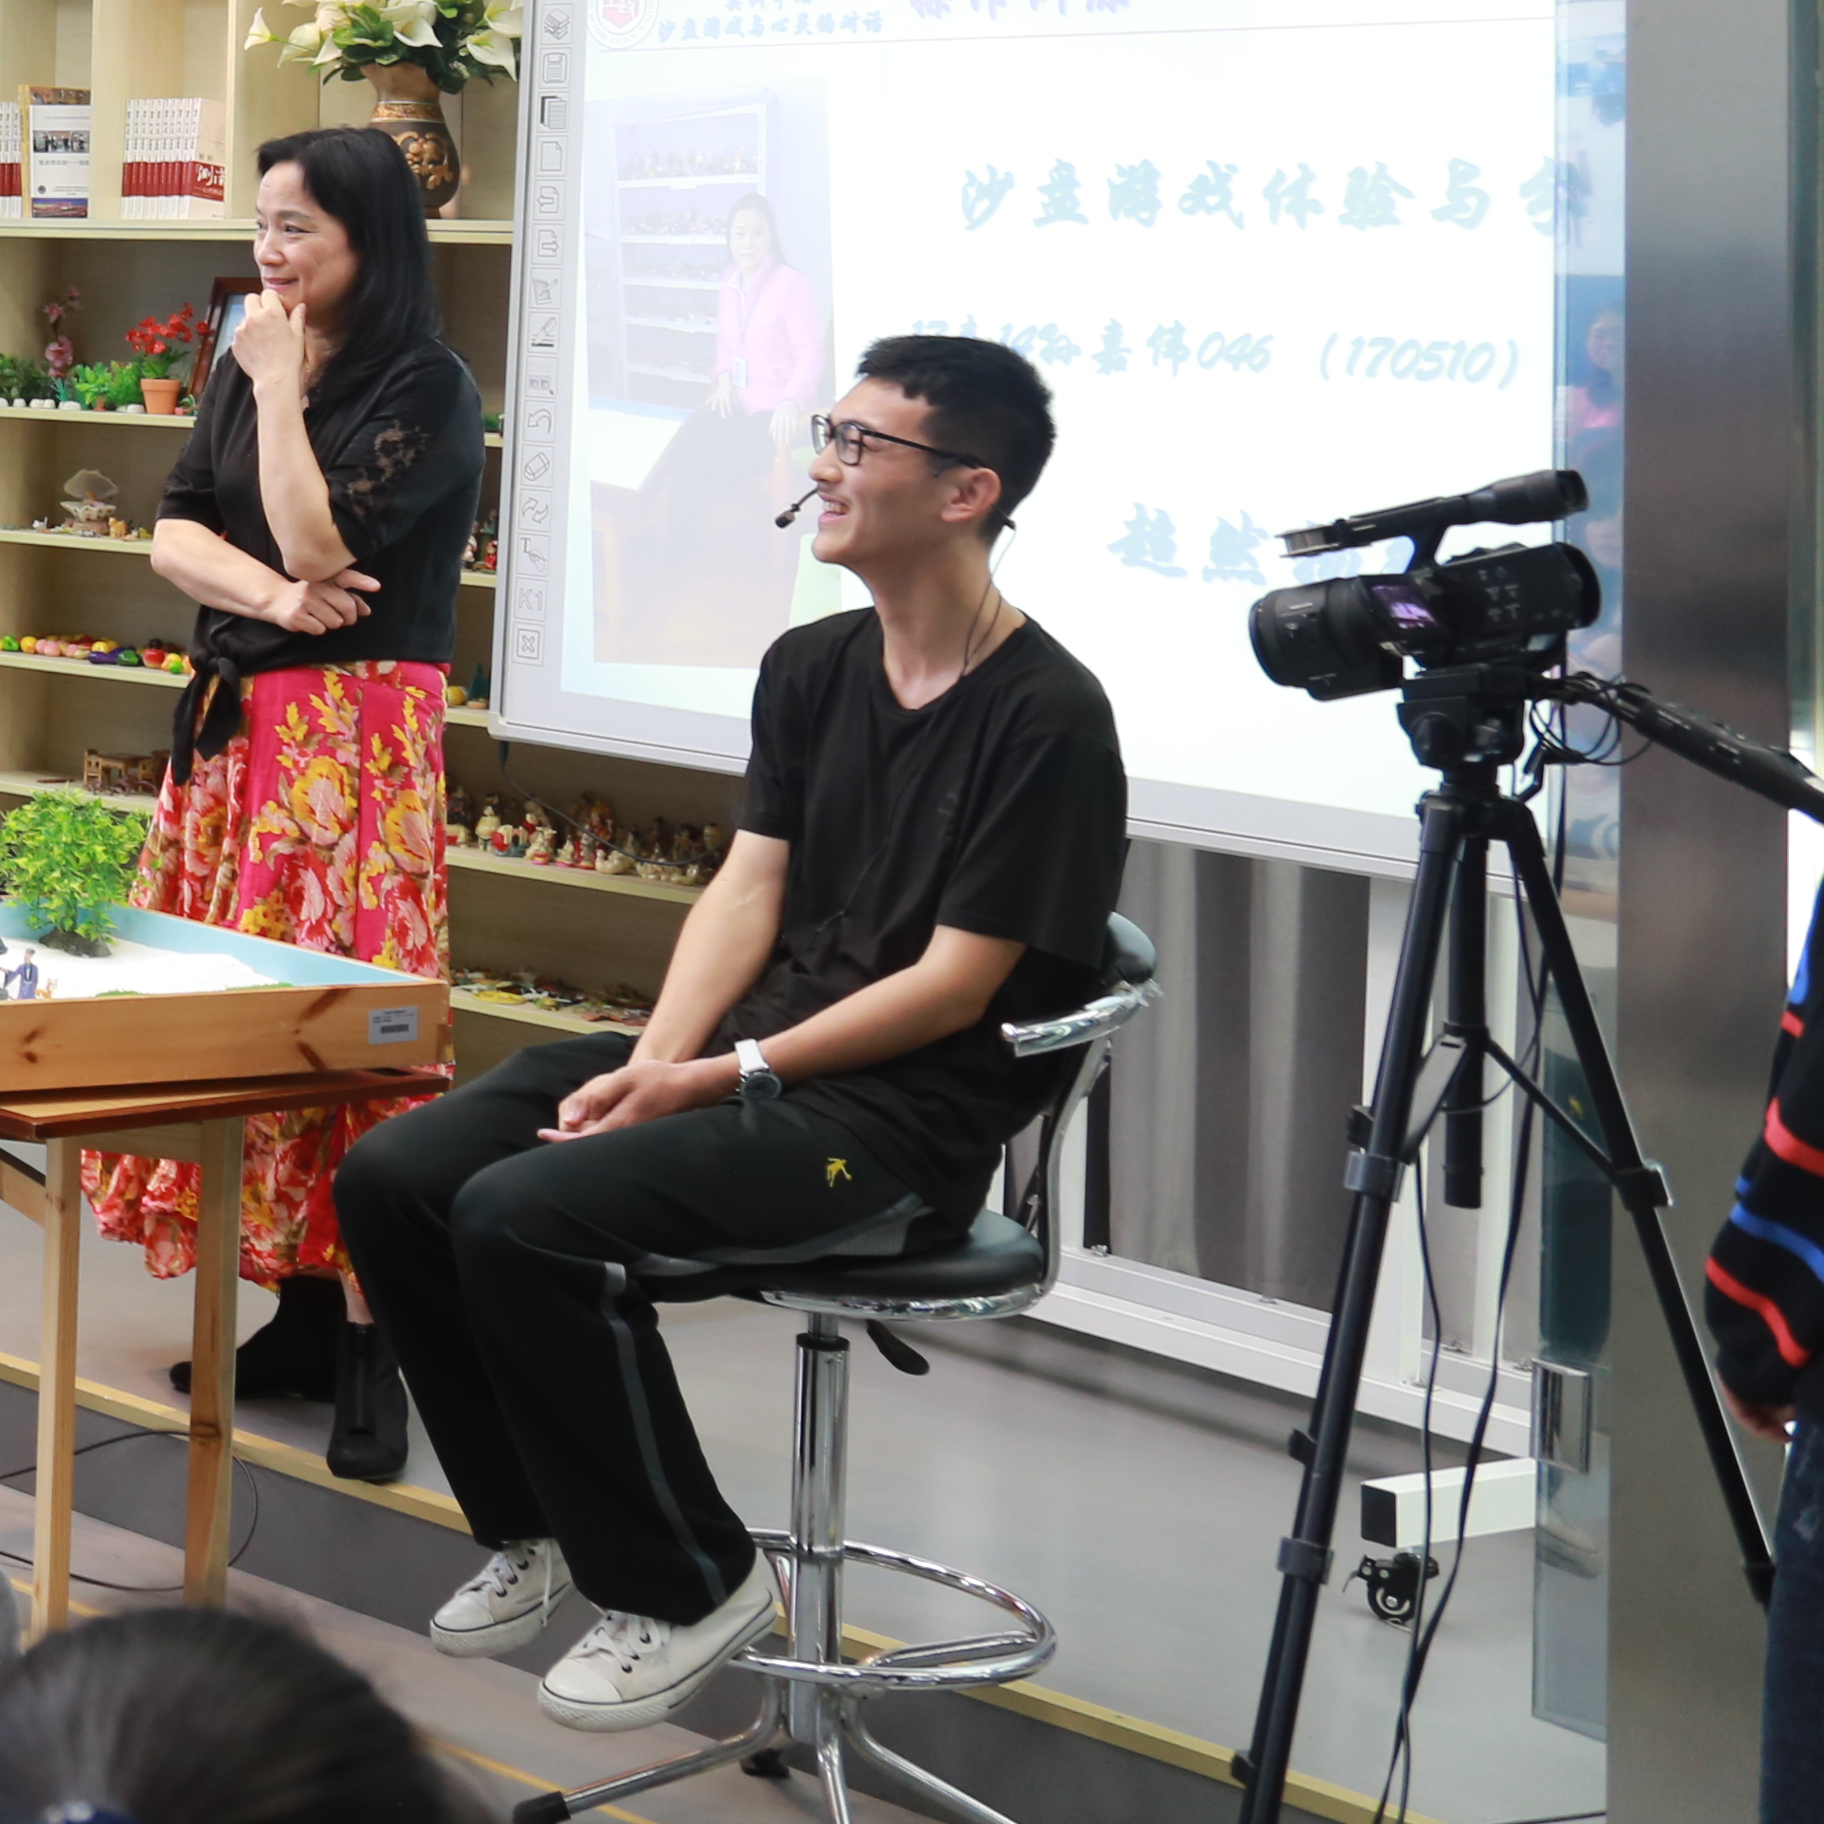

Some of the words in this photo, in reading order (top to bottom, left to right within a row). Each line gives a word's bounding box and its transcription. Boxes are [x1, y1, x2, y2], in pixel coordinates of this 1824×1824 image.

[658, 10, 884, 44] 沙盘游戏与心灵的对话
[518, 588, 543, 611] K1
